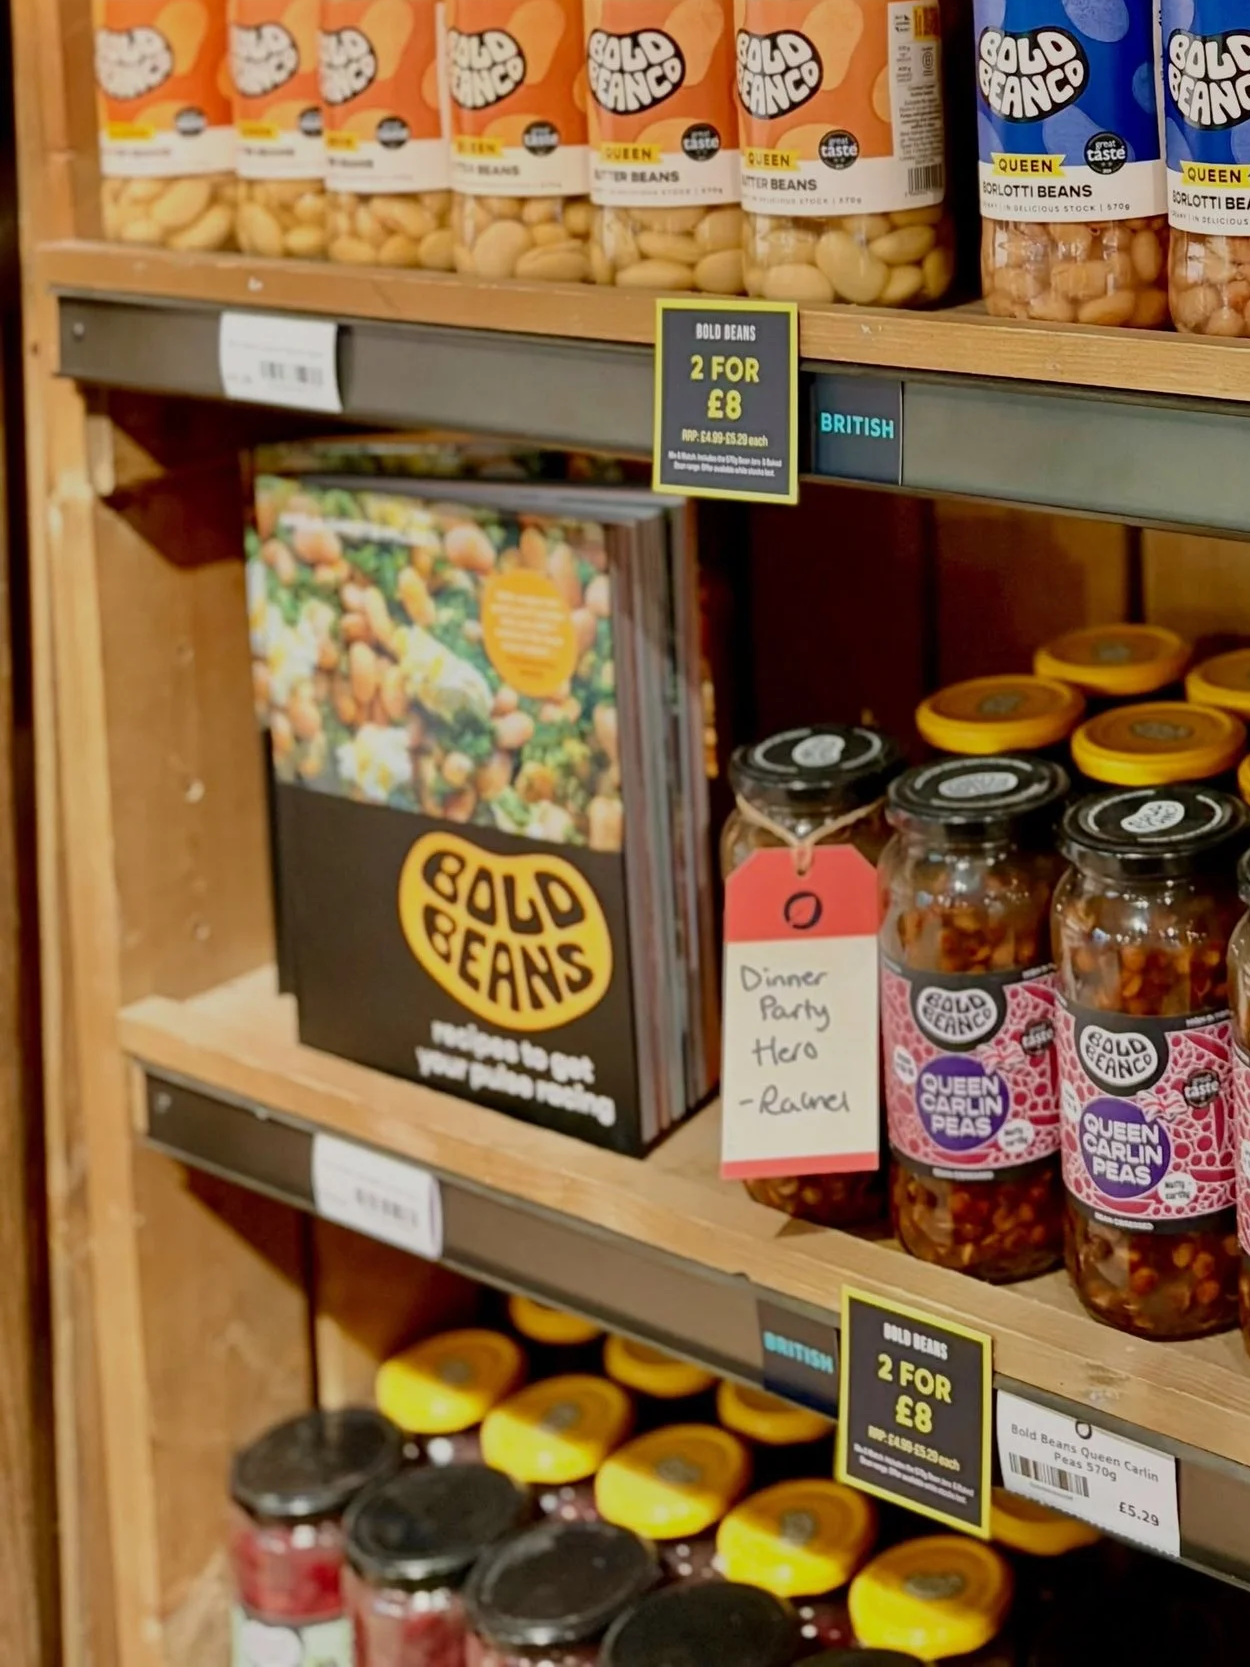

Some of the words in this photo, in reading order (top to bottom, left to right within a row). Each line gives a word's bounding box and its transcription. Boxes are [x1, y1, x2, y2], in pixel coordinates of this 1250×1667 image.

[690, 354, 704, 380] 2
[711, 356, 760, 383] FOR
[707, 389, 742, 421] £8
[820, 412, 895, 439] BRITISH
[421, 849, 586, 936] BOLD
[423, 903, 594, 1012] BEANS
[739, 965, 828, 992] Dinner
[759, 995, 831, 1033] Party
[752, 1037, 818, 1067] Hero
[877, 1353, 893, 1381] 2
[900, 1360, 952, 1404] FOR
[895, 1394, 933, 1434] £8
[1011, 1423, 1037, 1441] Bold
[1040, 1434, 1077, 1454] Beans
[1080, 1447, 1121, 1467] Queen
[1124, 1461, 1159, 1483] Carlin
[1053, 1451, 1083, 1470] Peas
[1086, 1463, 1117, 1482] 570g
[1118, 1501, 1160, 1527] £5.29
